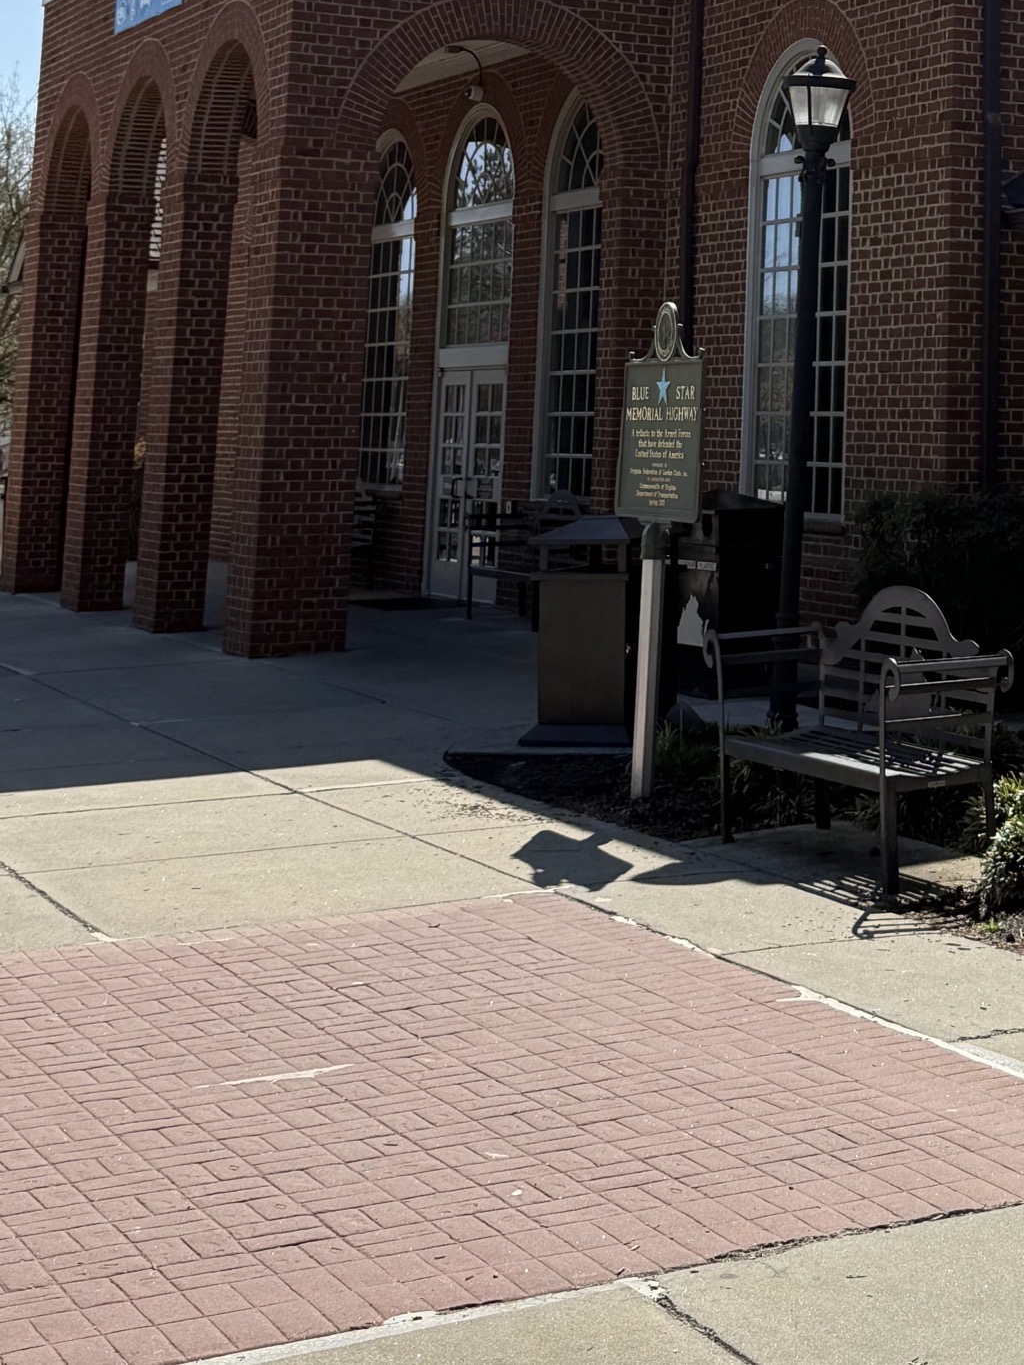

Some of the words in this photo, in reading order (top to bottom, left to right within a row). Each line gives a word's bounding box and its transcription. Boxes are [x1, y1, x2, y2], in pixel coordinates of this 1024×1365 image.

[632, 386, 650, 401] BLUE
[676, 385, 695, 400] STAR
[626, 406, 663, 421] MEMORIAL
[666, 406, 698, 421] HIGHWAY
